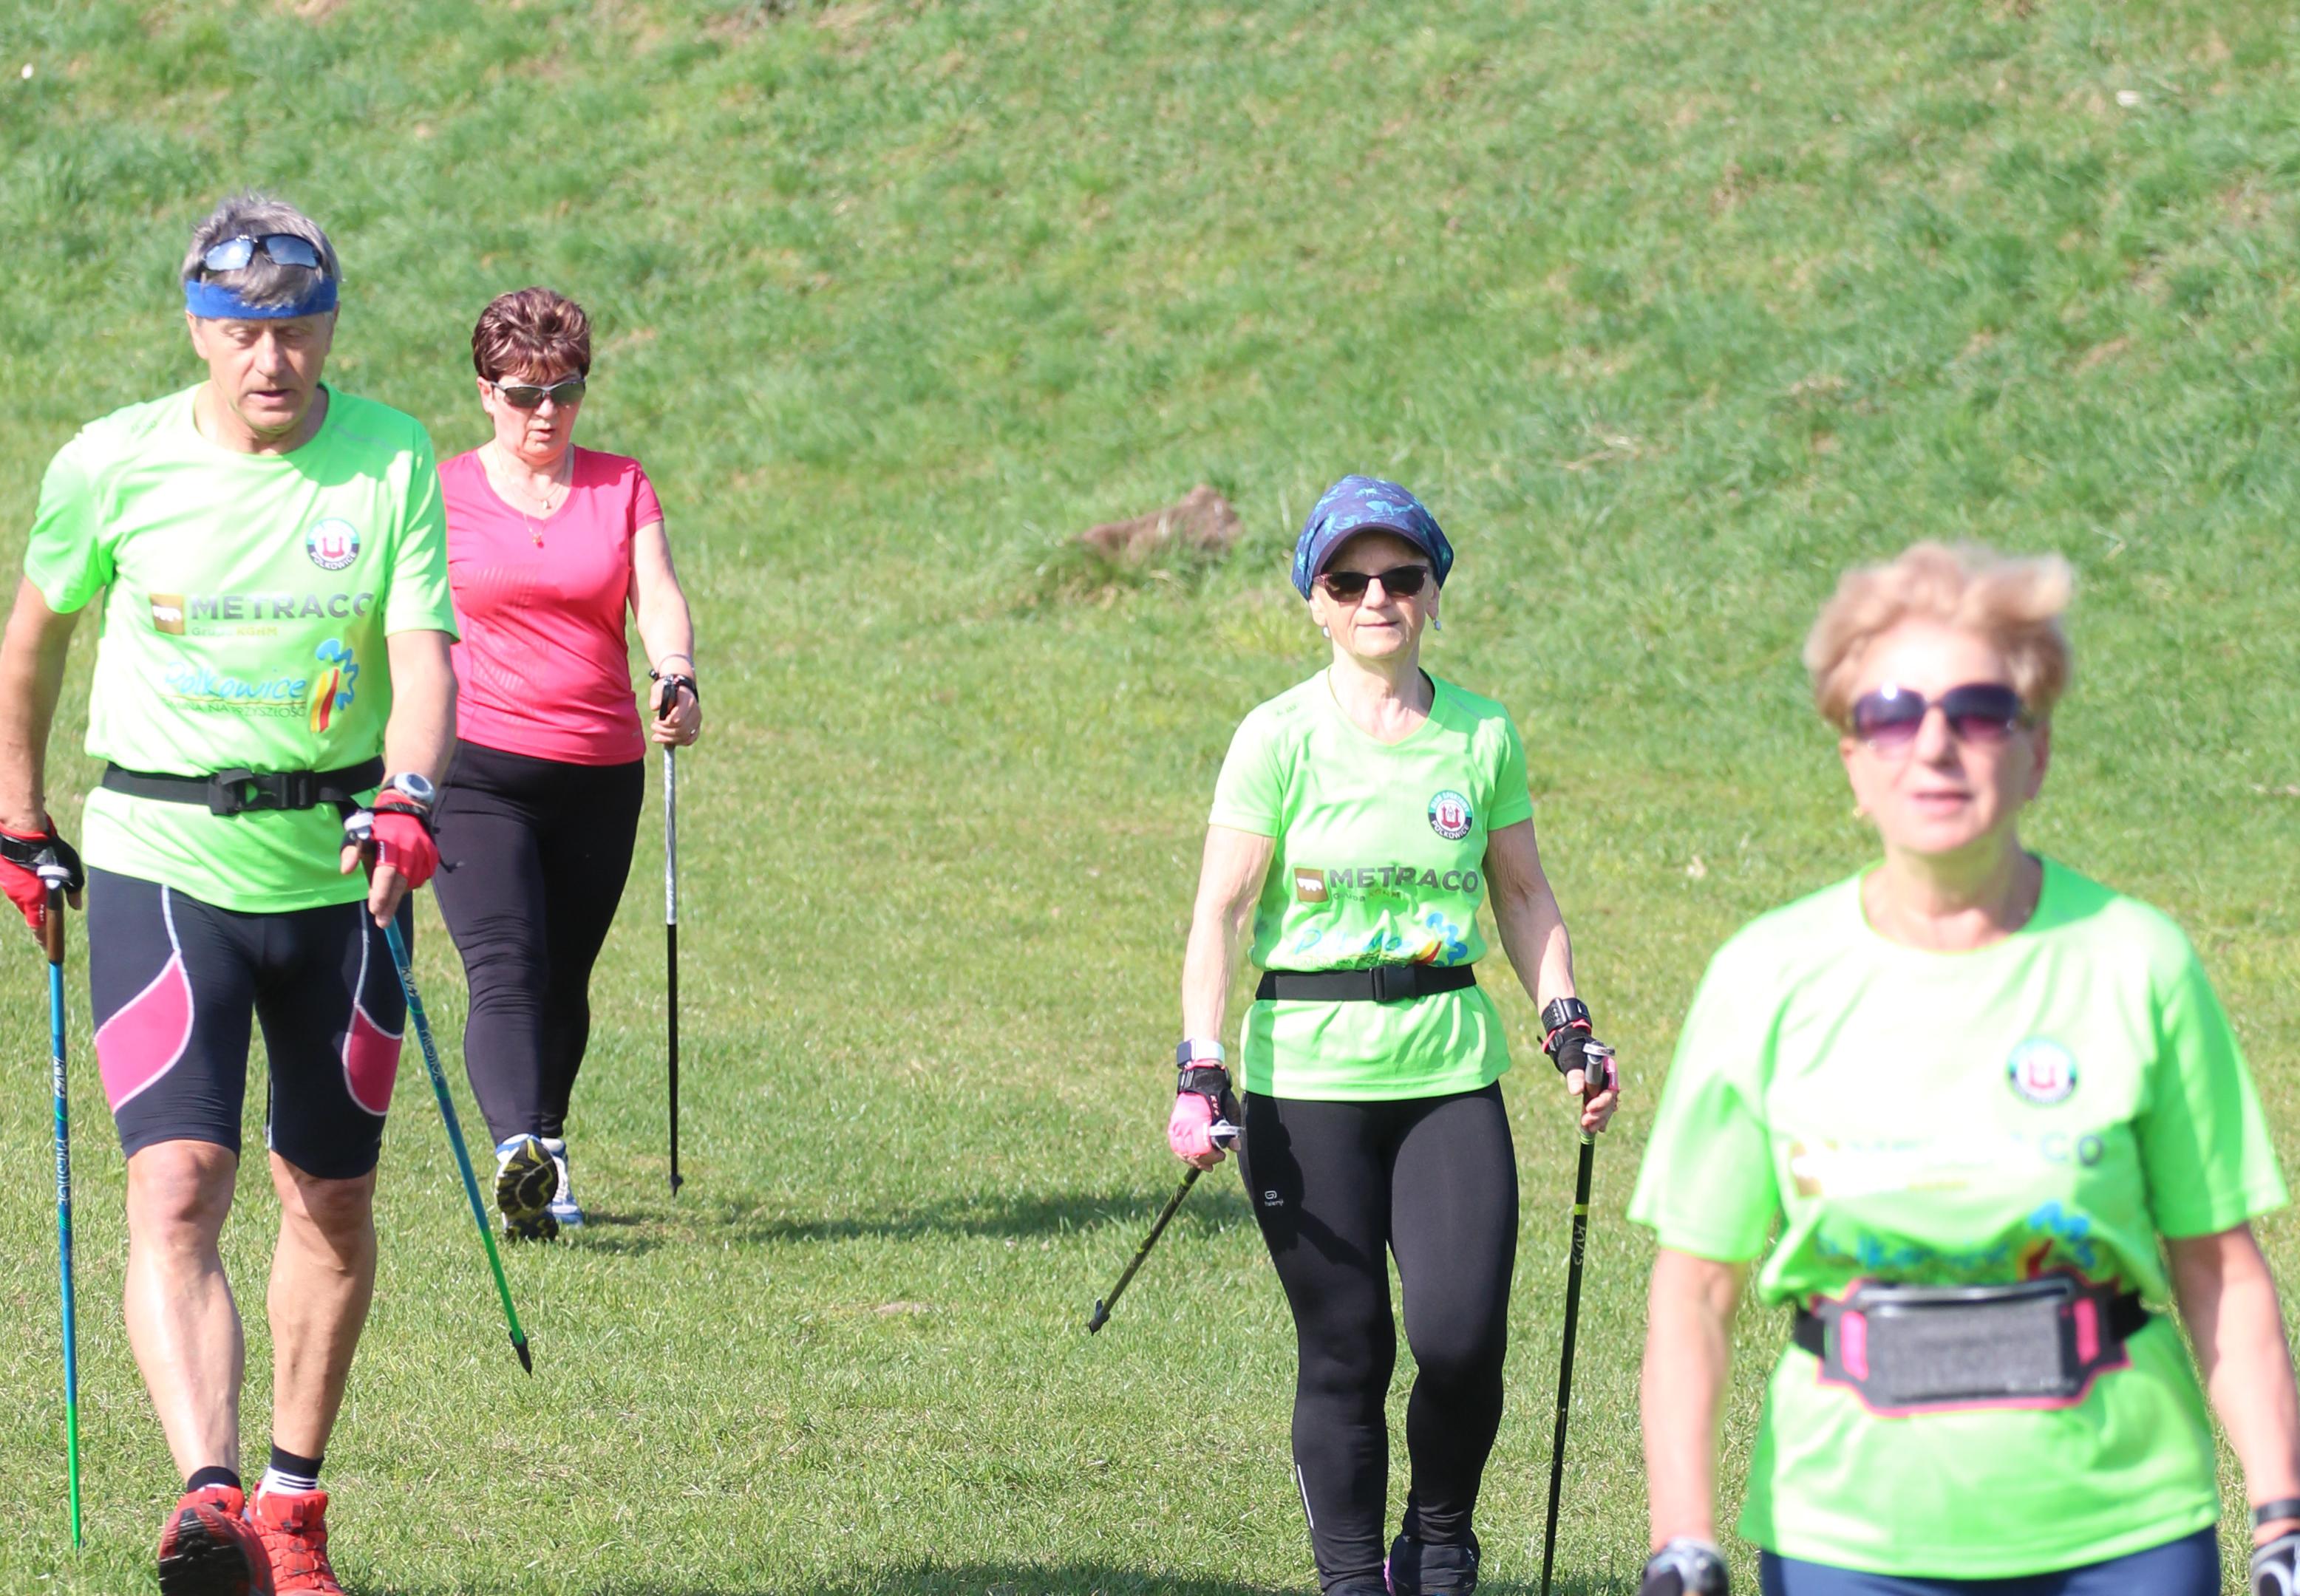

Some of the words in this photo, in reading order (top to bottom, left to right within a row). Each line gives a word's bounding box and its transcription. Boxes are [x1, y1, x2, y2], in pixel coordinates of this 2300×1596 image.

[1431, 819, 1469, 839] POLKOWICE
[1330, 867, 1479, 893] METRACO
[56, 1138, 70, 1206] PRESTIGE
